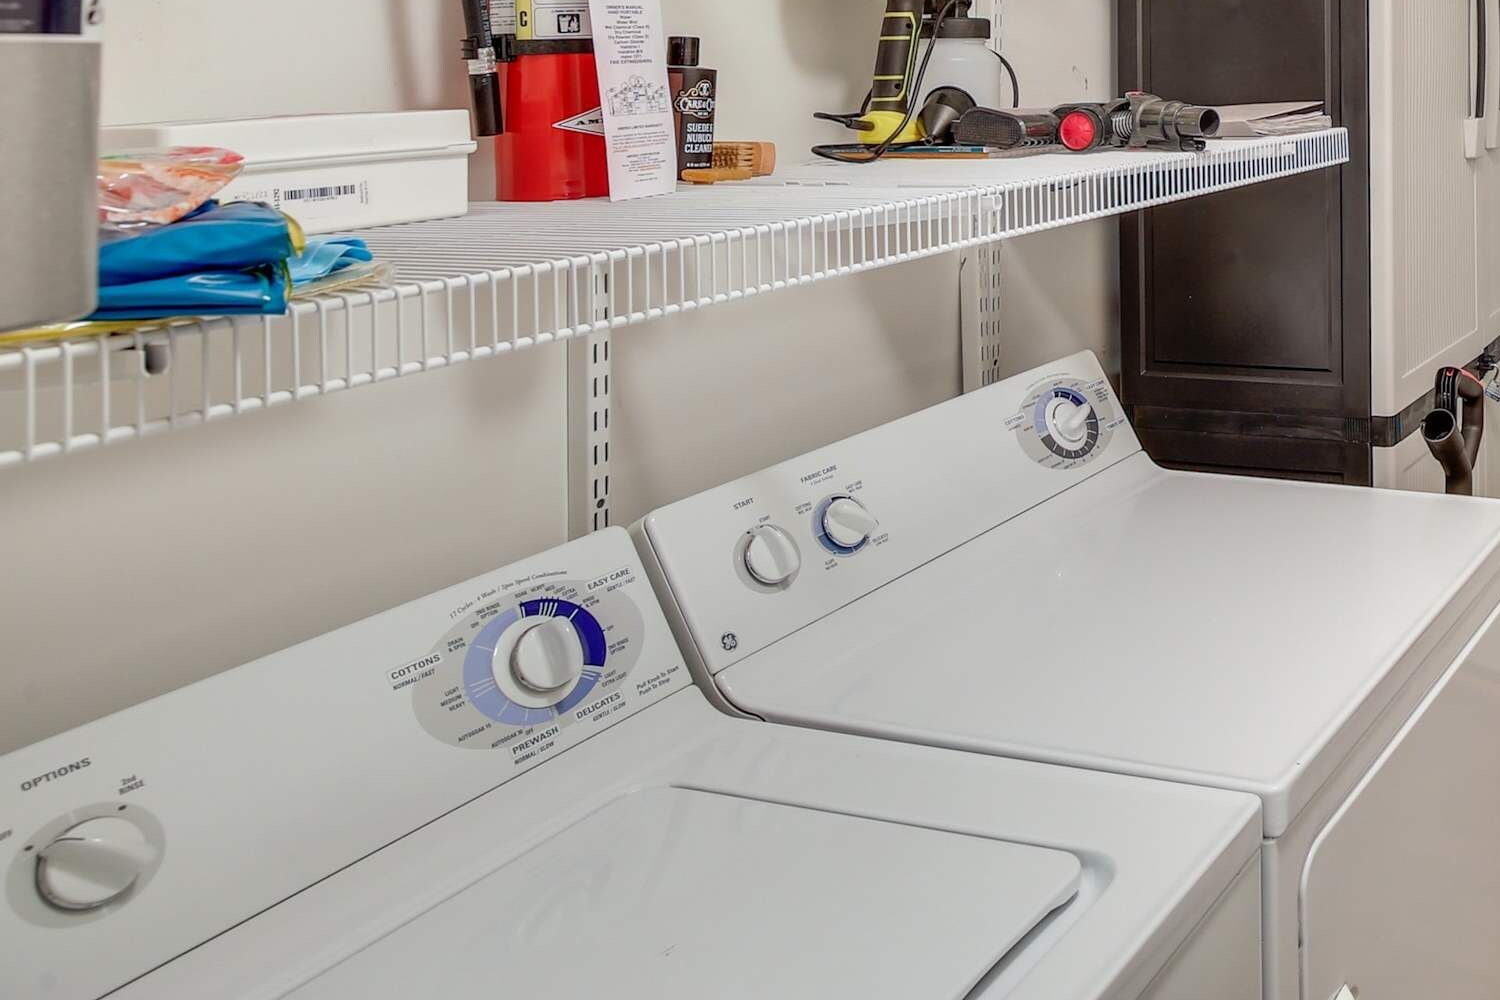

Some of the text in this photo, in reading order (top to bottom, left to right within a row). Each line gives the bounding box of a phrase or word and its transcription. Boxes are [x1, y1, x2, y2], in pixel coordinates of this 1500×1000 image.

[519, 11, 528, 27] C
[800, 471, 821, 484] FABRIC
[822, 464, 838, 476] CARE
[733, 497, 754, 511] START
[587, 567, 631, 591] EASY CARE
[391, 654, 441, 680] COTTONS
[575, 692, 622, 719] DELICATES
[512, 725, 560, 755] PREWASH
[20, 756, 92, 792] OPTIONS
